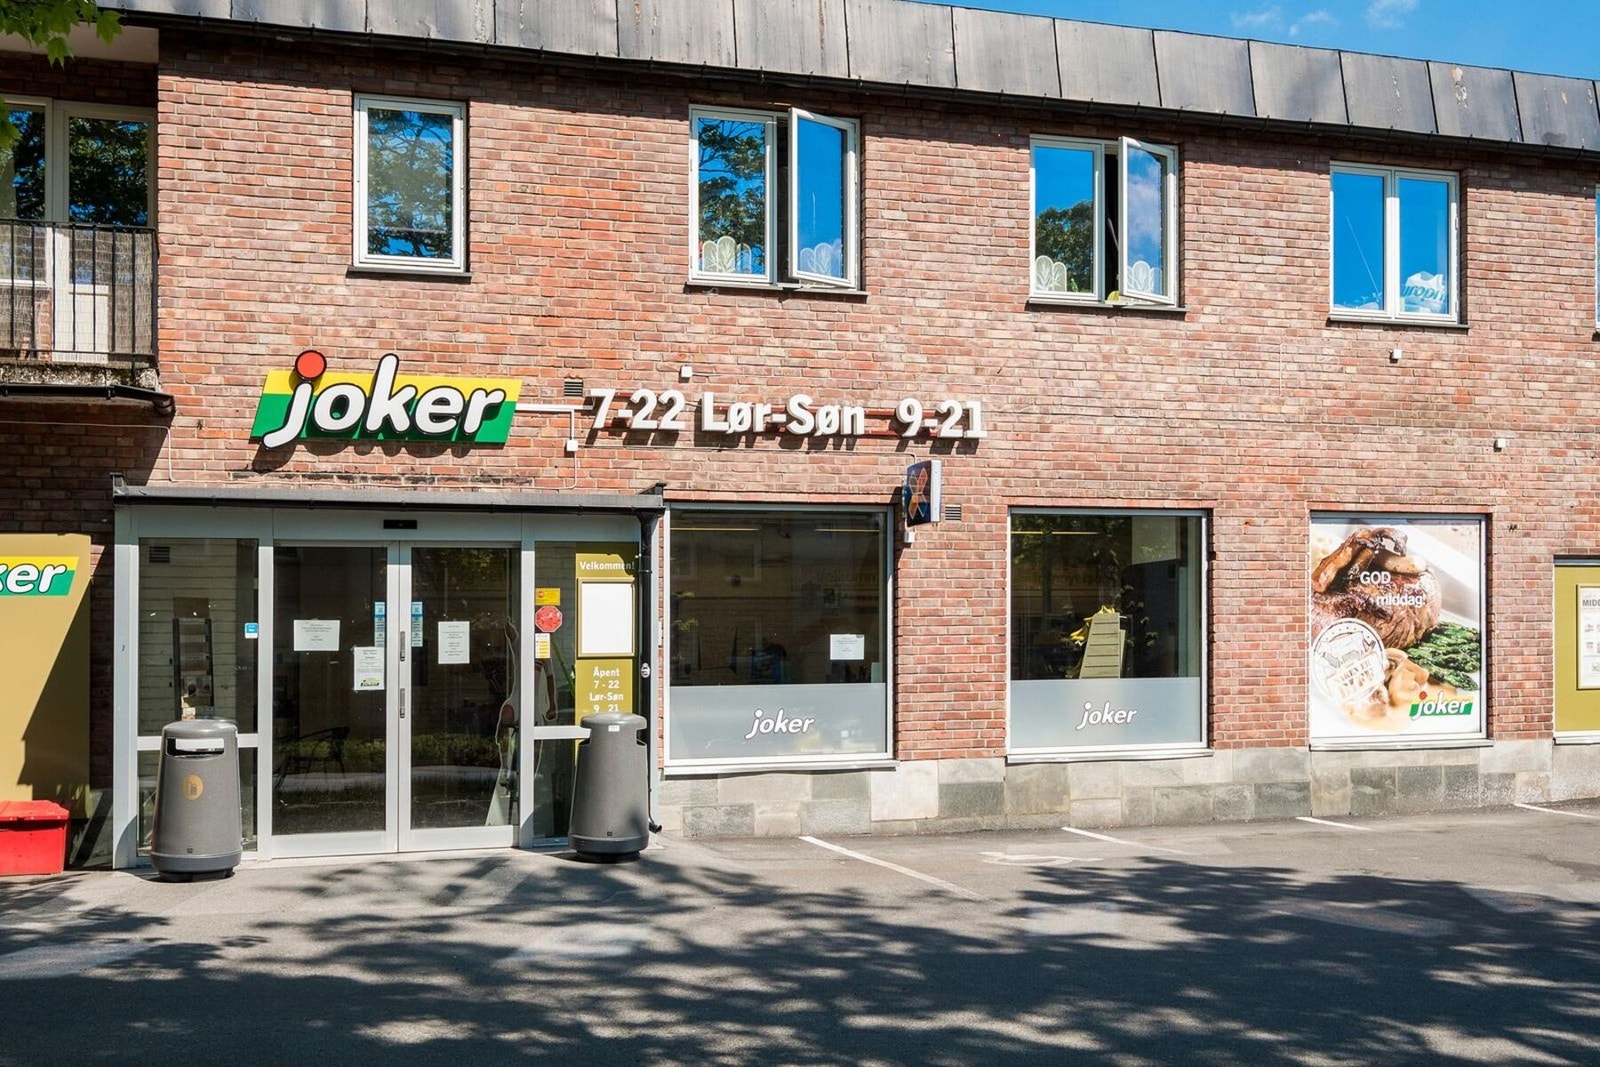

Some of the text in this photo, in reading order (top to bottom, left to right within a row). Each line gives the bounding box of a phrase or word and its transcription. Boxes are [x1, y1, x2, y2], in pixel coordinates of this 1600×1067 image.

[262, 350, 507, 449] joker
[590, 388, 988, 438] 7-22 Lør-Søn 9-21
[580, 561, 635, 571] Velkommen!
[1360, 571, 1391, 585] GOD
[1376, 593, 1426, 608] middag!
[593, 665, 620, 679] Åpent
[593, 680, 600, 689] 7
[608, 680, 620, 689] 22
[589, 691, 624, 702] Lør-Søn
[593, 703, 619, 713] 9 21
[1411, 691, 1471, 721] joker
[1075, 701, 1138, 731] joker
[744, 708, 815, 740] joker
